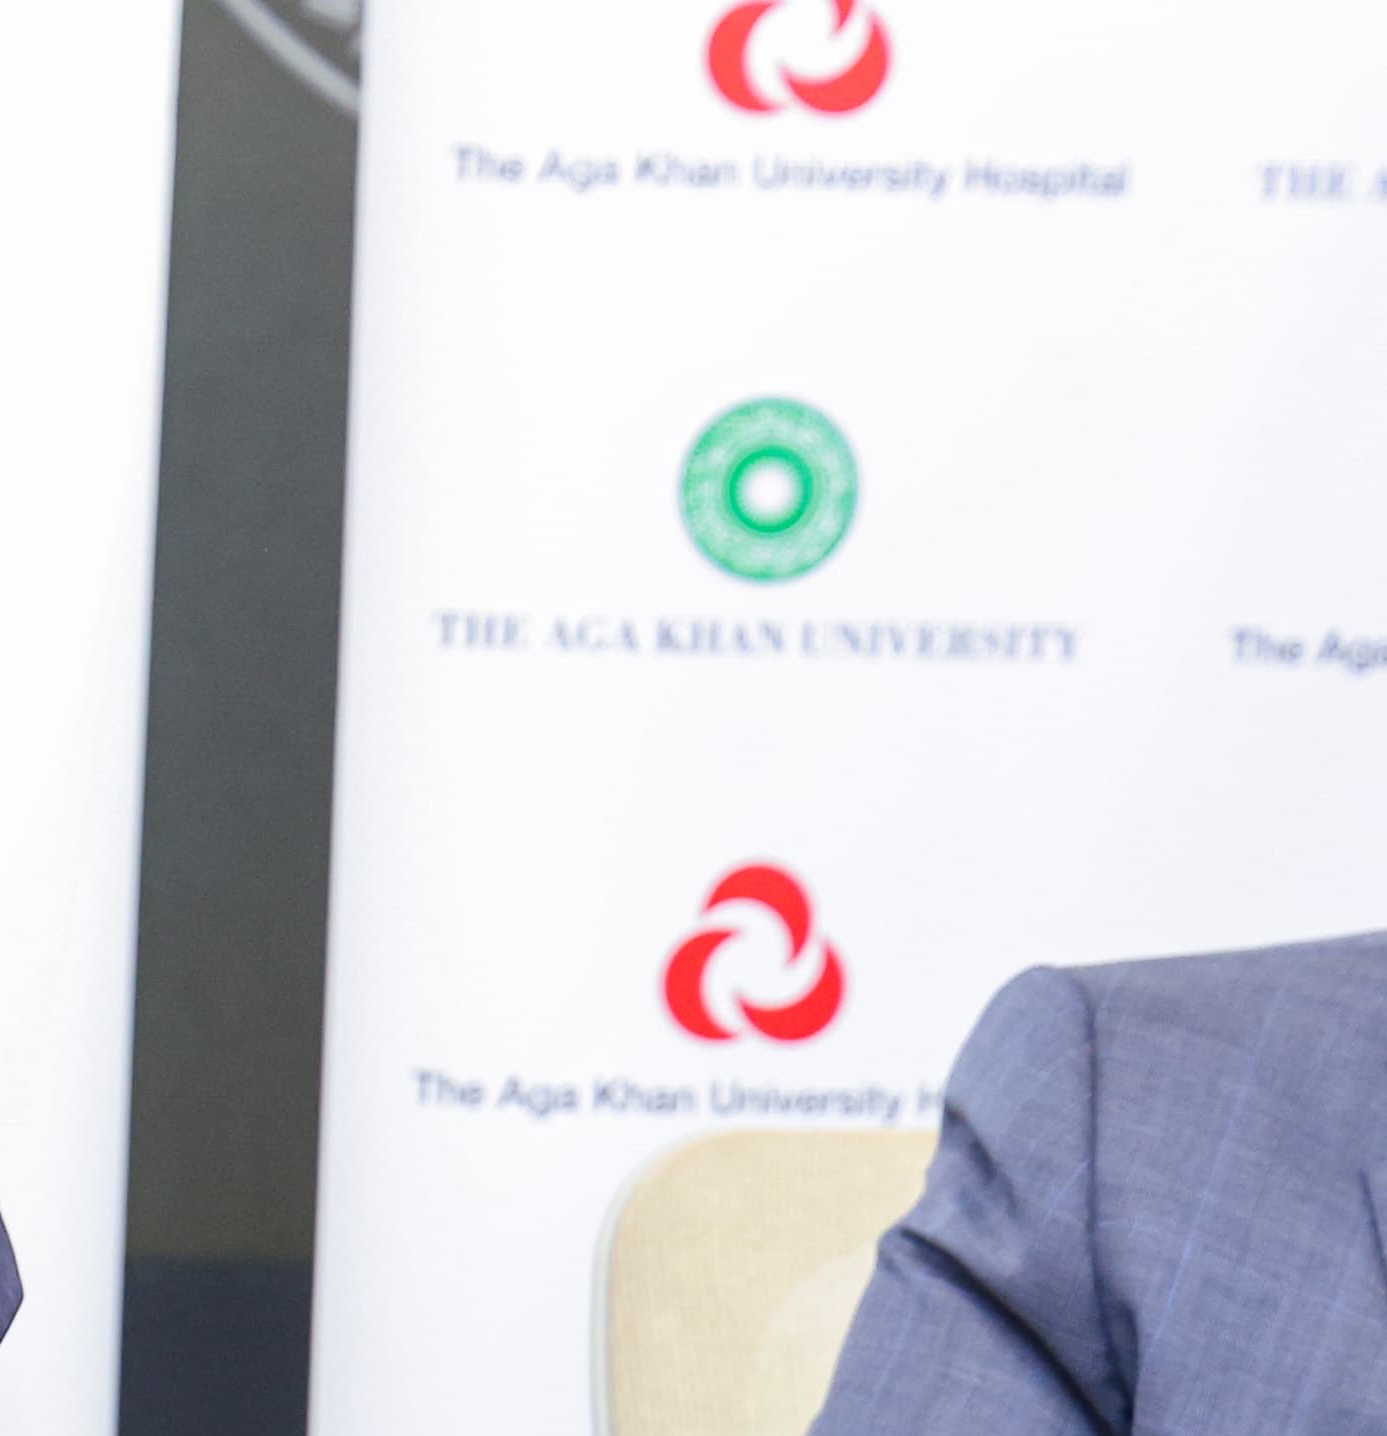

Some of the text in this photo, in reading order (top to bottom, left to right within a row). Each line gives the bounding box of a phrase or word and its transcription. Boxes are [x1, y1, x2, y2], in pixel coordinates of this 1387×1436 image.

[451, 143, 1133, 202] The Aga Khan University Hospital
[1259, 162, 1354, 203] THE
[432, 609, 1081, 664] THE AGA KHAN UNIVERSITY
[1231, 626, 1305, 667] The
[412, 1068, 486, 1110] The
[496, 1076, 580, 1121] Aga
[592, 1078, 699, 1117] Khan
[709, 1080, 904, 1127] University
